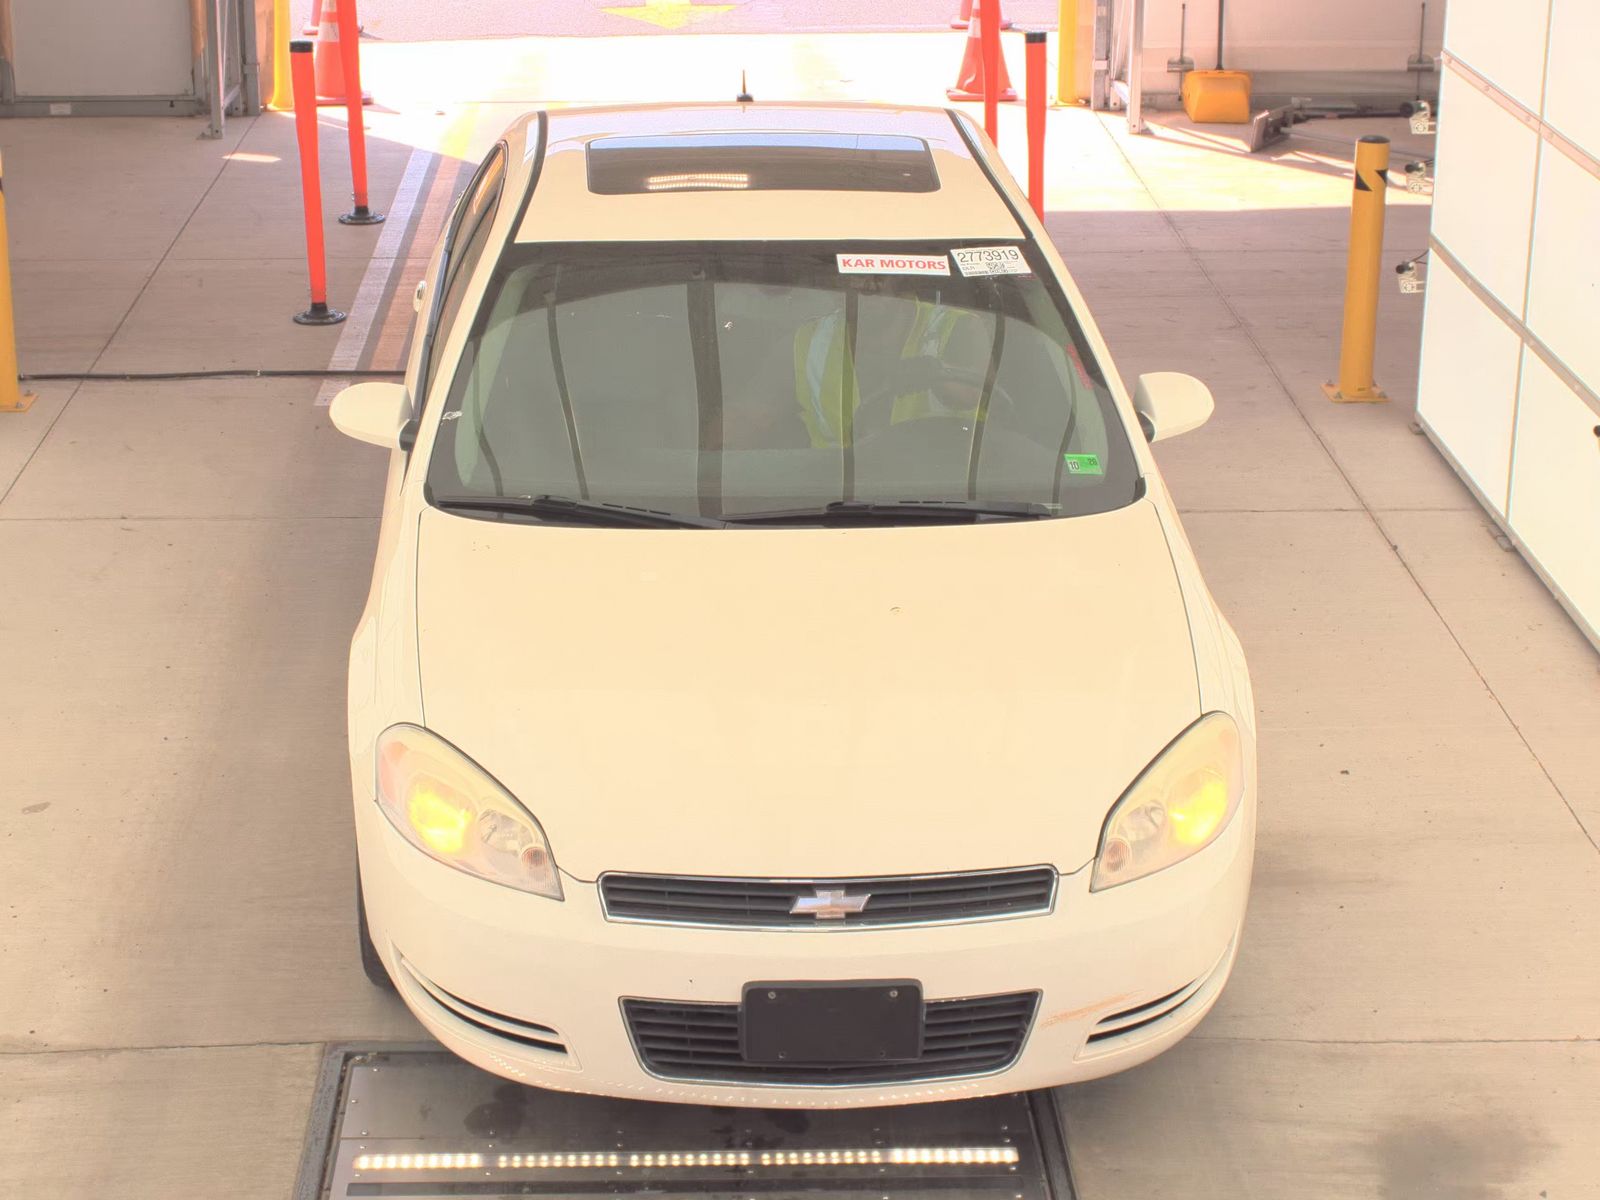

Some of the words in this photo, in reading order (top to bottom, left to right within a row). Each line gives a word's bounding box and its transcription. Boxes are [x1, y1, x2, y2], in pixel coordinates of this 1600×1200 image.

[957, 249, 1019, 262] 2773919
[842, 258, 875, 268] KAR
[880, 259, 947, 270] MOTORS
